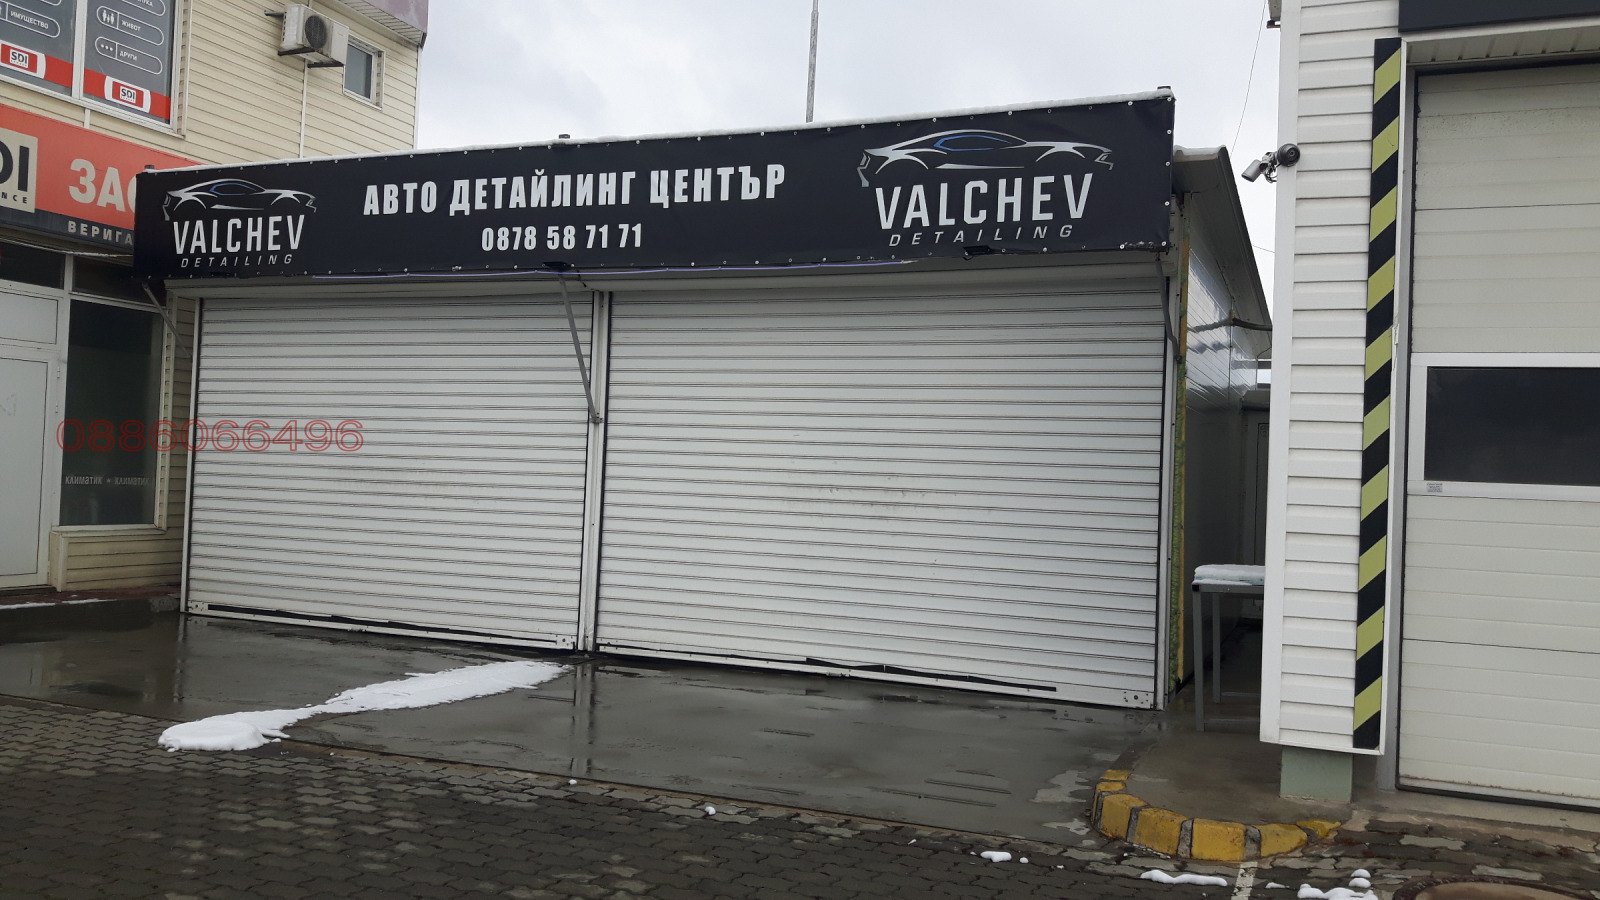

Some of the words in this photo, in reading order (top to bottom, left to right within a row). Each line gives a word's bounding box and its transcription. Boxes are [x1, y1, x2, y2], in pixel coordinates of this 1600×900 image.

[10, 10, 49, 29] ИМУЩЕСТВО
[121, 20, 141, 31] ЖИВОТ
[11, 51, 28, 64] SDI
[119, 50, 138, 61] ДРУГИ
[121, 88, 136, 99] SDI
[69, 158, 136, 213] ЗА
[363, 181, 437, 216] АВТО
[449, 169, 635, 216] ДЕТАЙЛИНГ
[650, 164, 785, 208] ЦЕНТЪР
[873, 172, 1093, 230] VALCHEV
[67, 220, 133, 246] ВЕРИГА
[173, 214, 305, 255] VALCHEV
[481, 226, 537, 252] 0878
[546, 225, 576, 250] 58
[585, 224, 609, 249] 71
[618, 223, 642, 248] 71
[888, 224, 1073, 247] DETAILING
[180, 253, 293, 268] DETAILING
